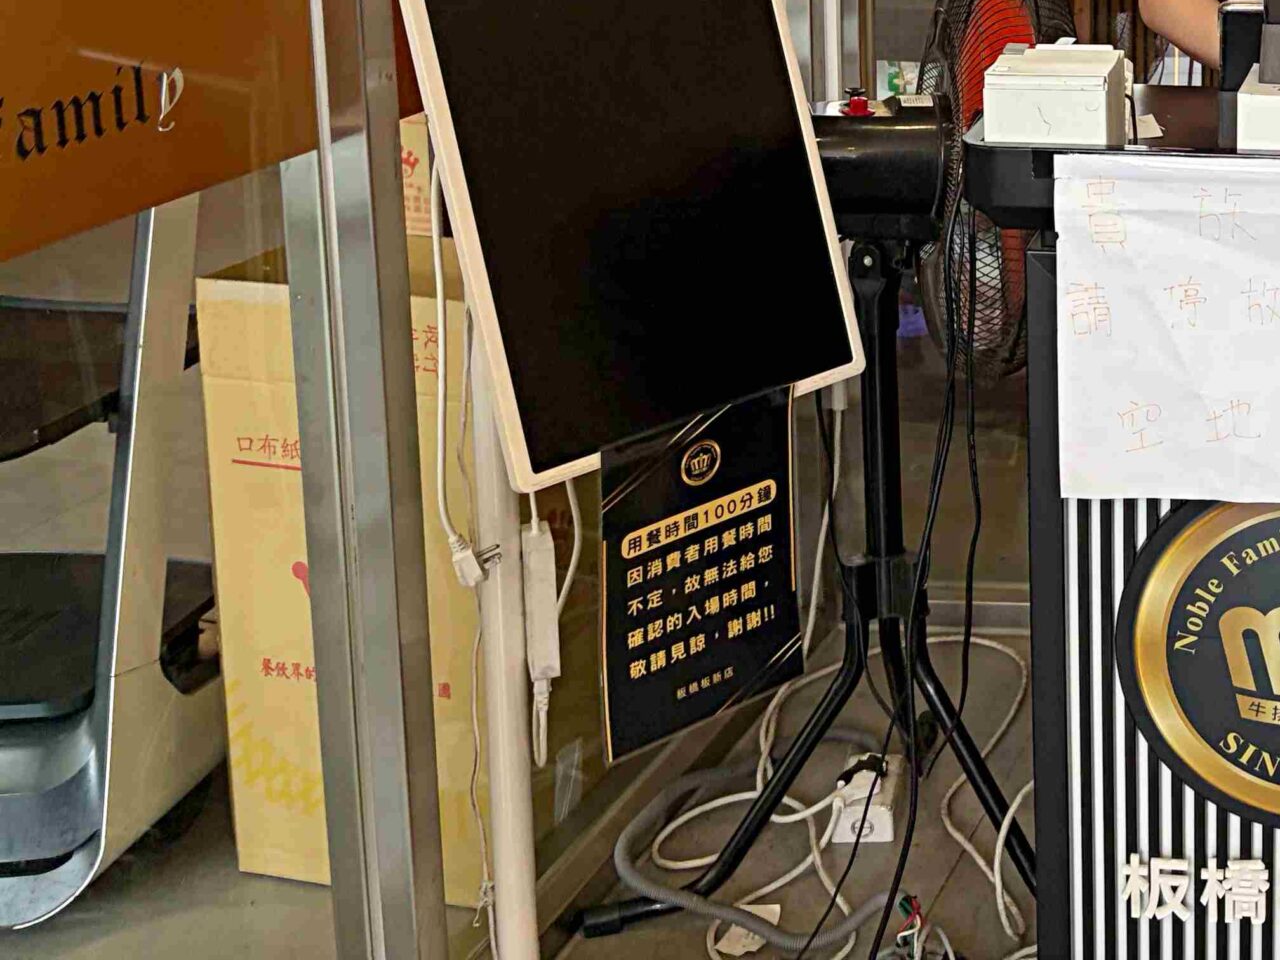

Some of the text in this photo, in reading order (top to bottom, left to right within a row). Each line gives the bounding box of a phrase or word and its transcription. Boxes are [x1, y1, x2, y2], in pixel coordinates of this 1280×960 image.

[0, 61, 184, 161] amily
[626, 484, 773, 555] 用餐時間100分鐘
[626, 514, 773, 588] 因消費者用餐時間
[1173, 577, 1224, 655] Noble
